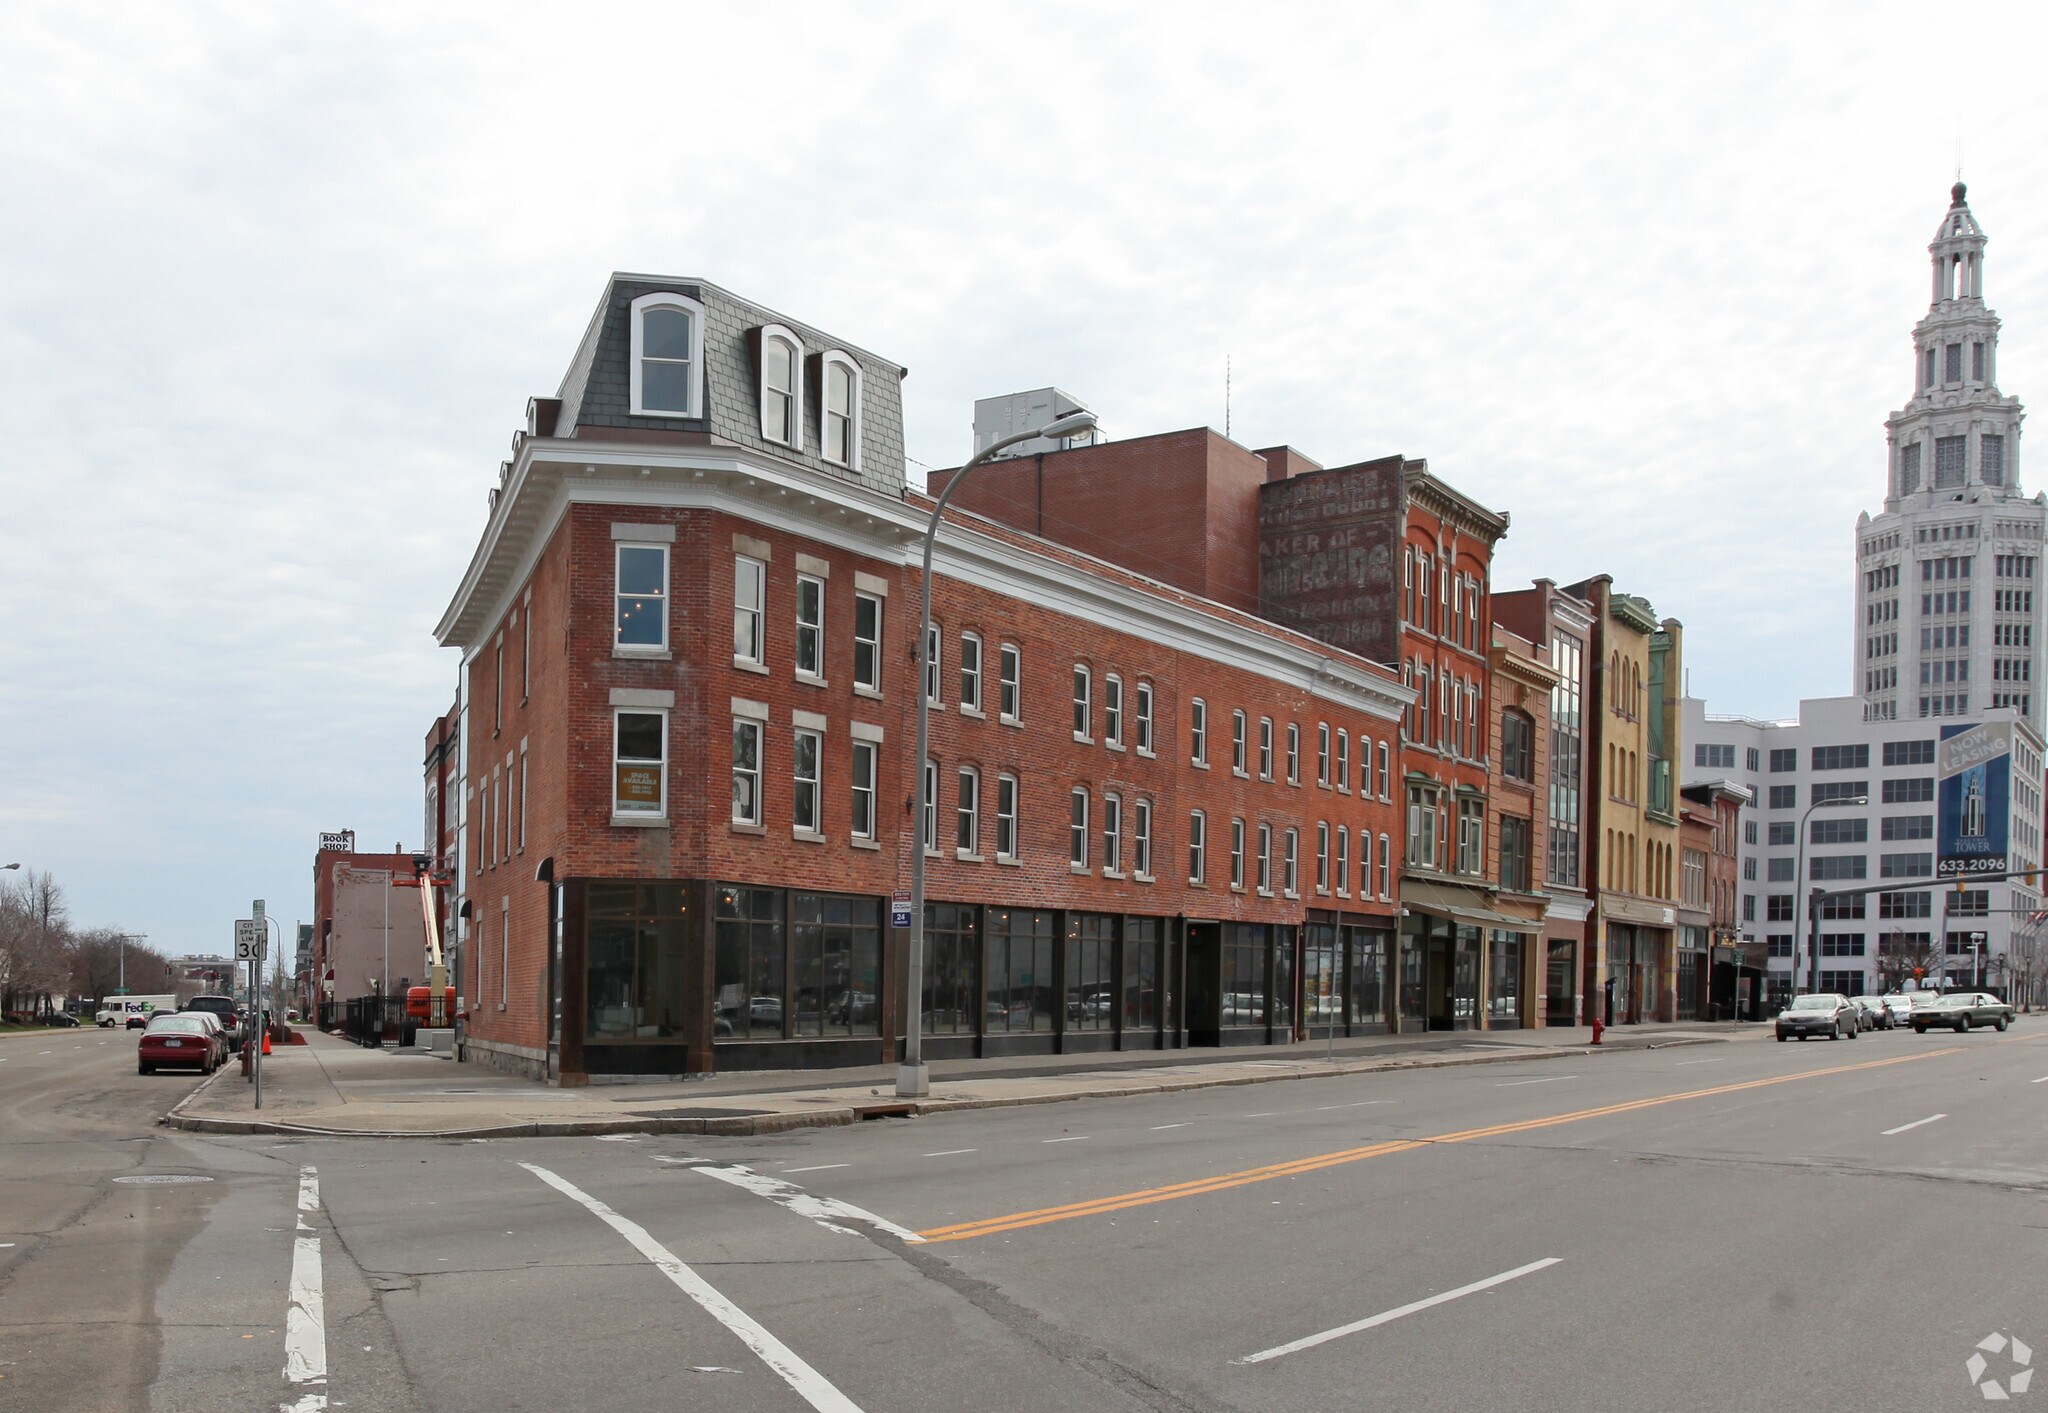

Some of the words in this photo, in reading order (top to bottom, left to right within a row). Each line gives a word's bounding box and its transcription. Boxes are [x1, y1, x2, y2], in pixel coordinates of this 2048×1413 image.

[1950, 730, 1987, 754] NOW
[1943, 738, 2006, 771] LEASING
[323, 835, 349, 843] BOOK
[1954, 842, 1990, 853] TOWER
[1939, 858, 2005, 871] 633.2096
[125, 1001, 156, 1013] FedEx
